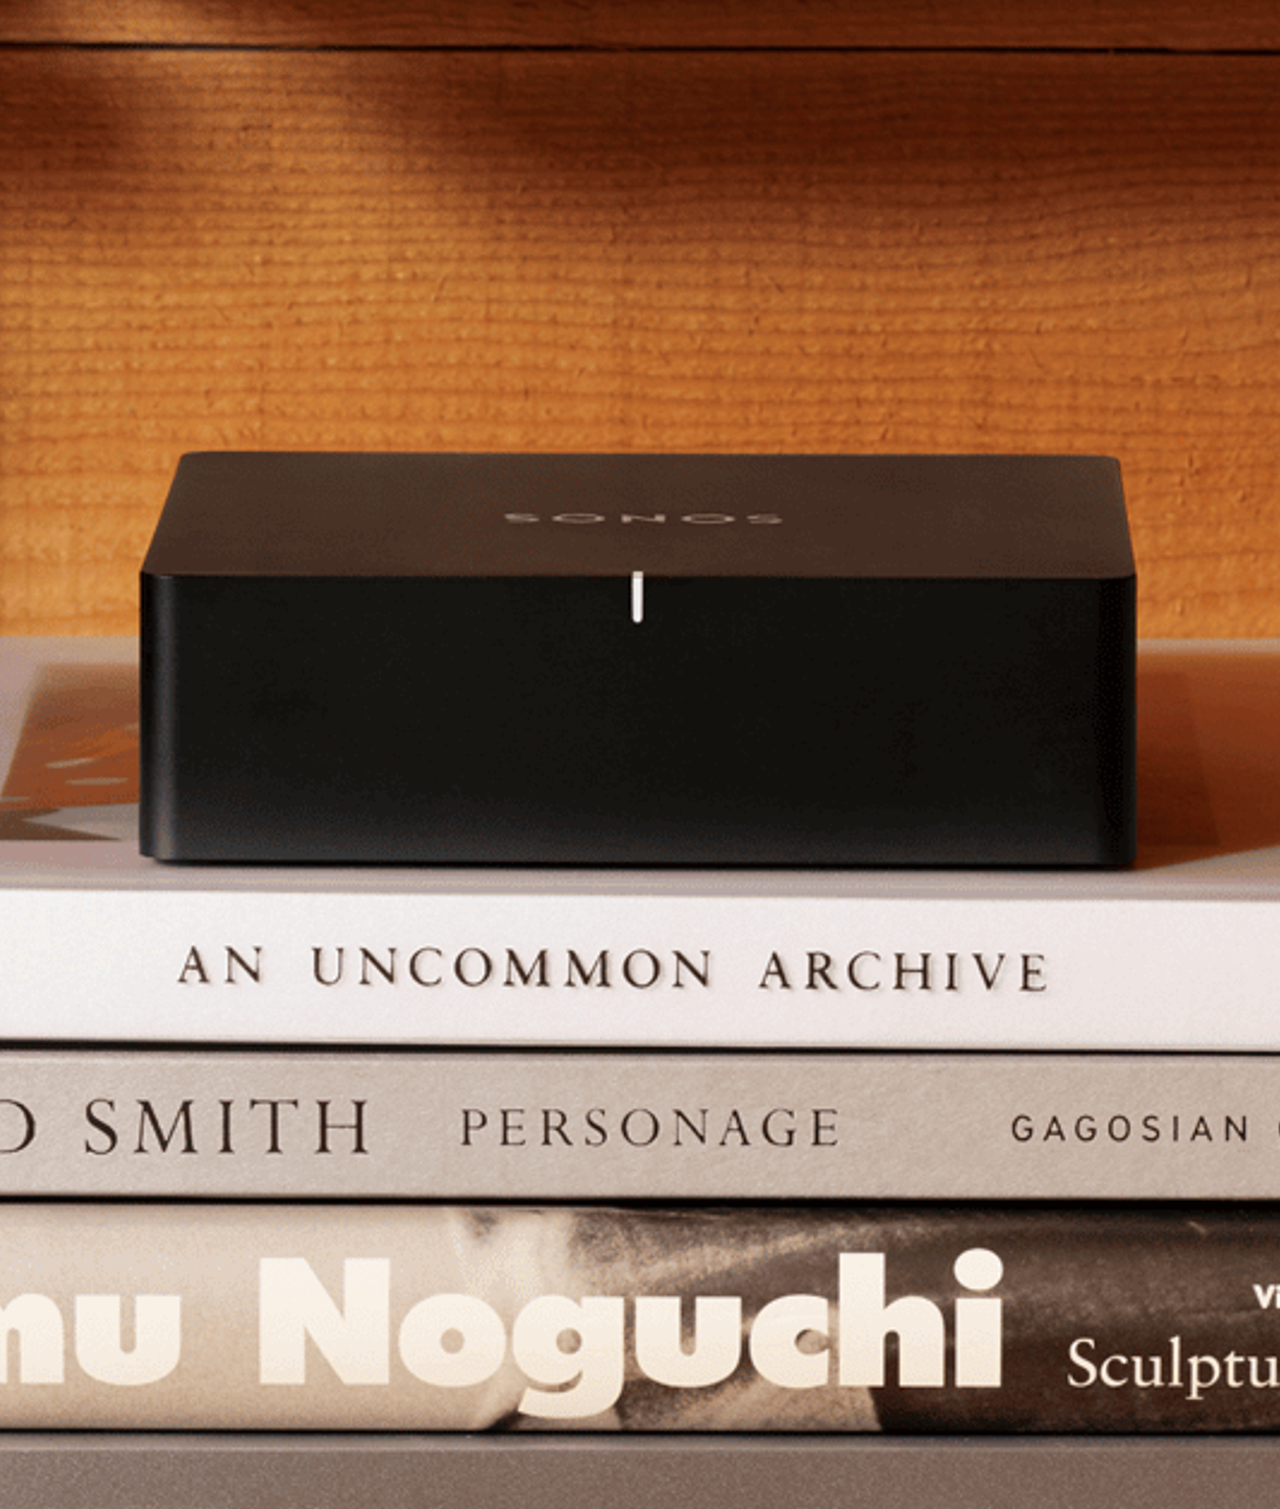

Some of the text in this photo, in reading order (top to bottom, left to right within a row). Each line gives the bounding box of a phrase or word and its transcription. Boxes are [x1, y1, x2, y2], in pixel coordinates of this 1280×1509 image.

[504, 512, 784, 524] SONOS
[177, 946, 1048, 993] AN UNCOMMON ARCHIVE
[83, 1099, 369, 1156] SMITH
[460, 1109, 839, 1147] PERSONAGE
[1011, 1115, 1247, 1143] GAGOSIAN
[259, 1248, 1003, 1417] Noguchi
